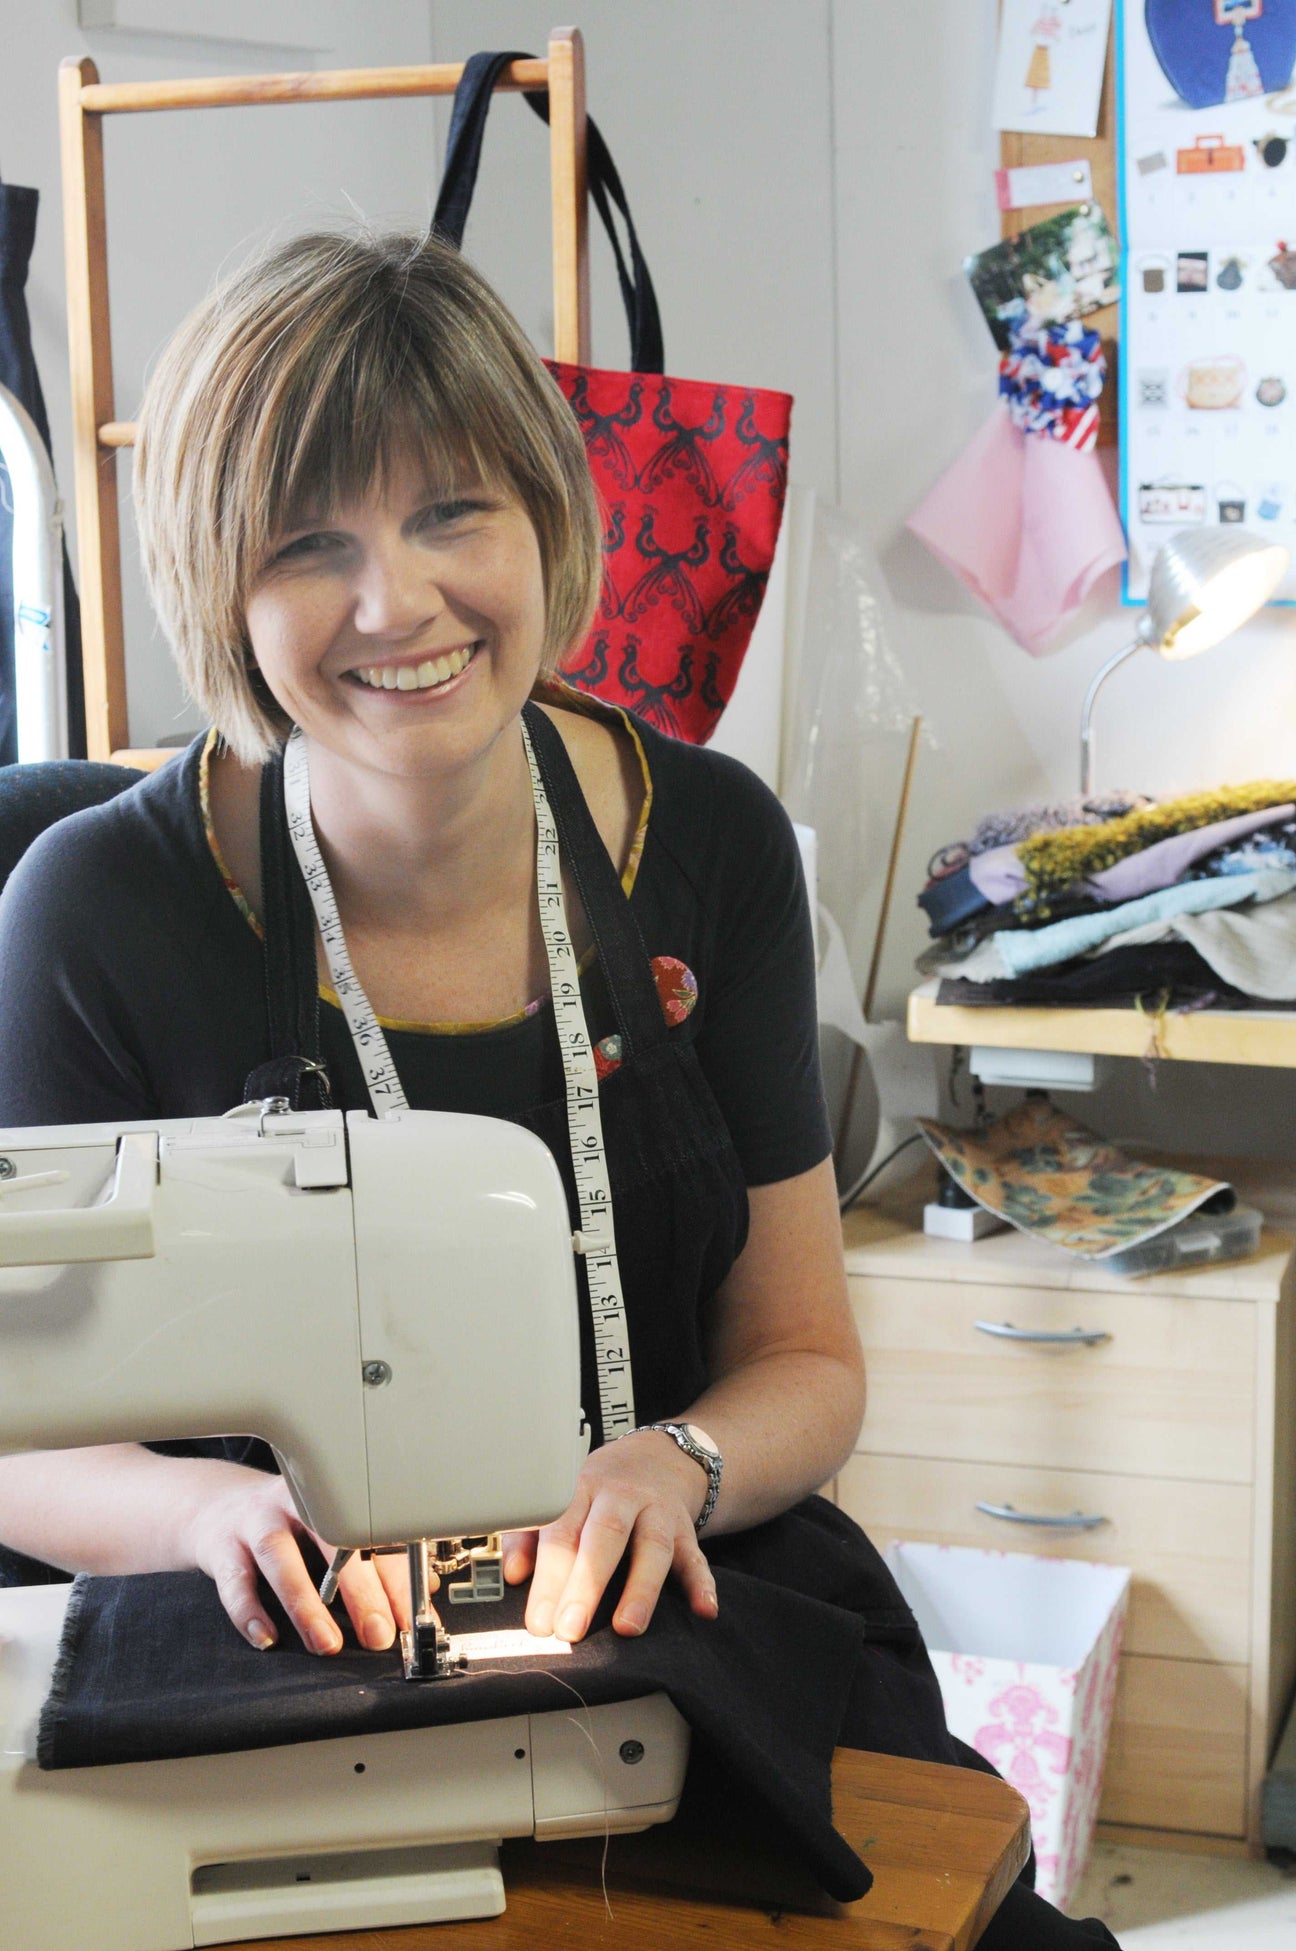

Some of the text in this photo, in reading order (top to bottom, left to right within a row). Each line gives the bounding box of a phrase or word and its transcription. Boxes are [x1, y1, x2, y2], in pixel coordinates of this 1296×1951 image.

[290, 812, 305, 841] 32
[545, 827, 556, 856] 22
[304, 863, 322, 891] 33
[546, 882, 560, 907] 21
[552, 930, 571, 958] 20
[334, 967, 353, 995] 35
[560, 982, 577, 1009] 19
[354, 1017, 373, 1046] 36
[568, 1032, 588, 1059] 18
[369, 1067, 391, 1094] 37
[577, 1086, 594, 1111] 17
[580, 1136, 600, 1163] 16
[589, 1189, 607, 1216] 15
[601, 1294, 620, 1320] 13
[607, 1347, 625, 1374] 12
[611, 1402, 629, 1426] 11
